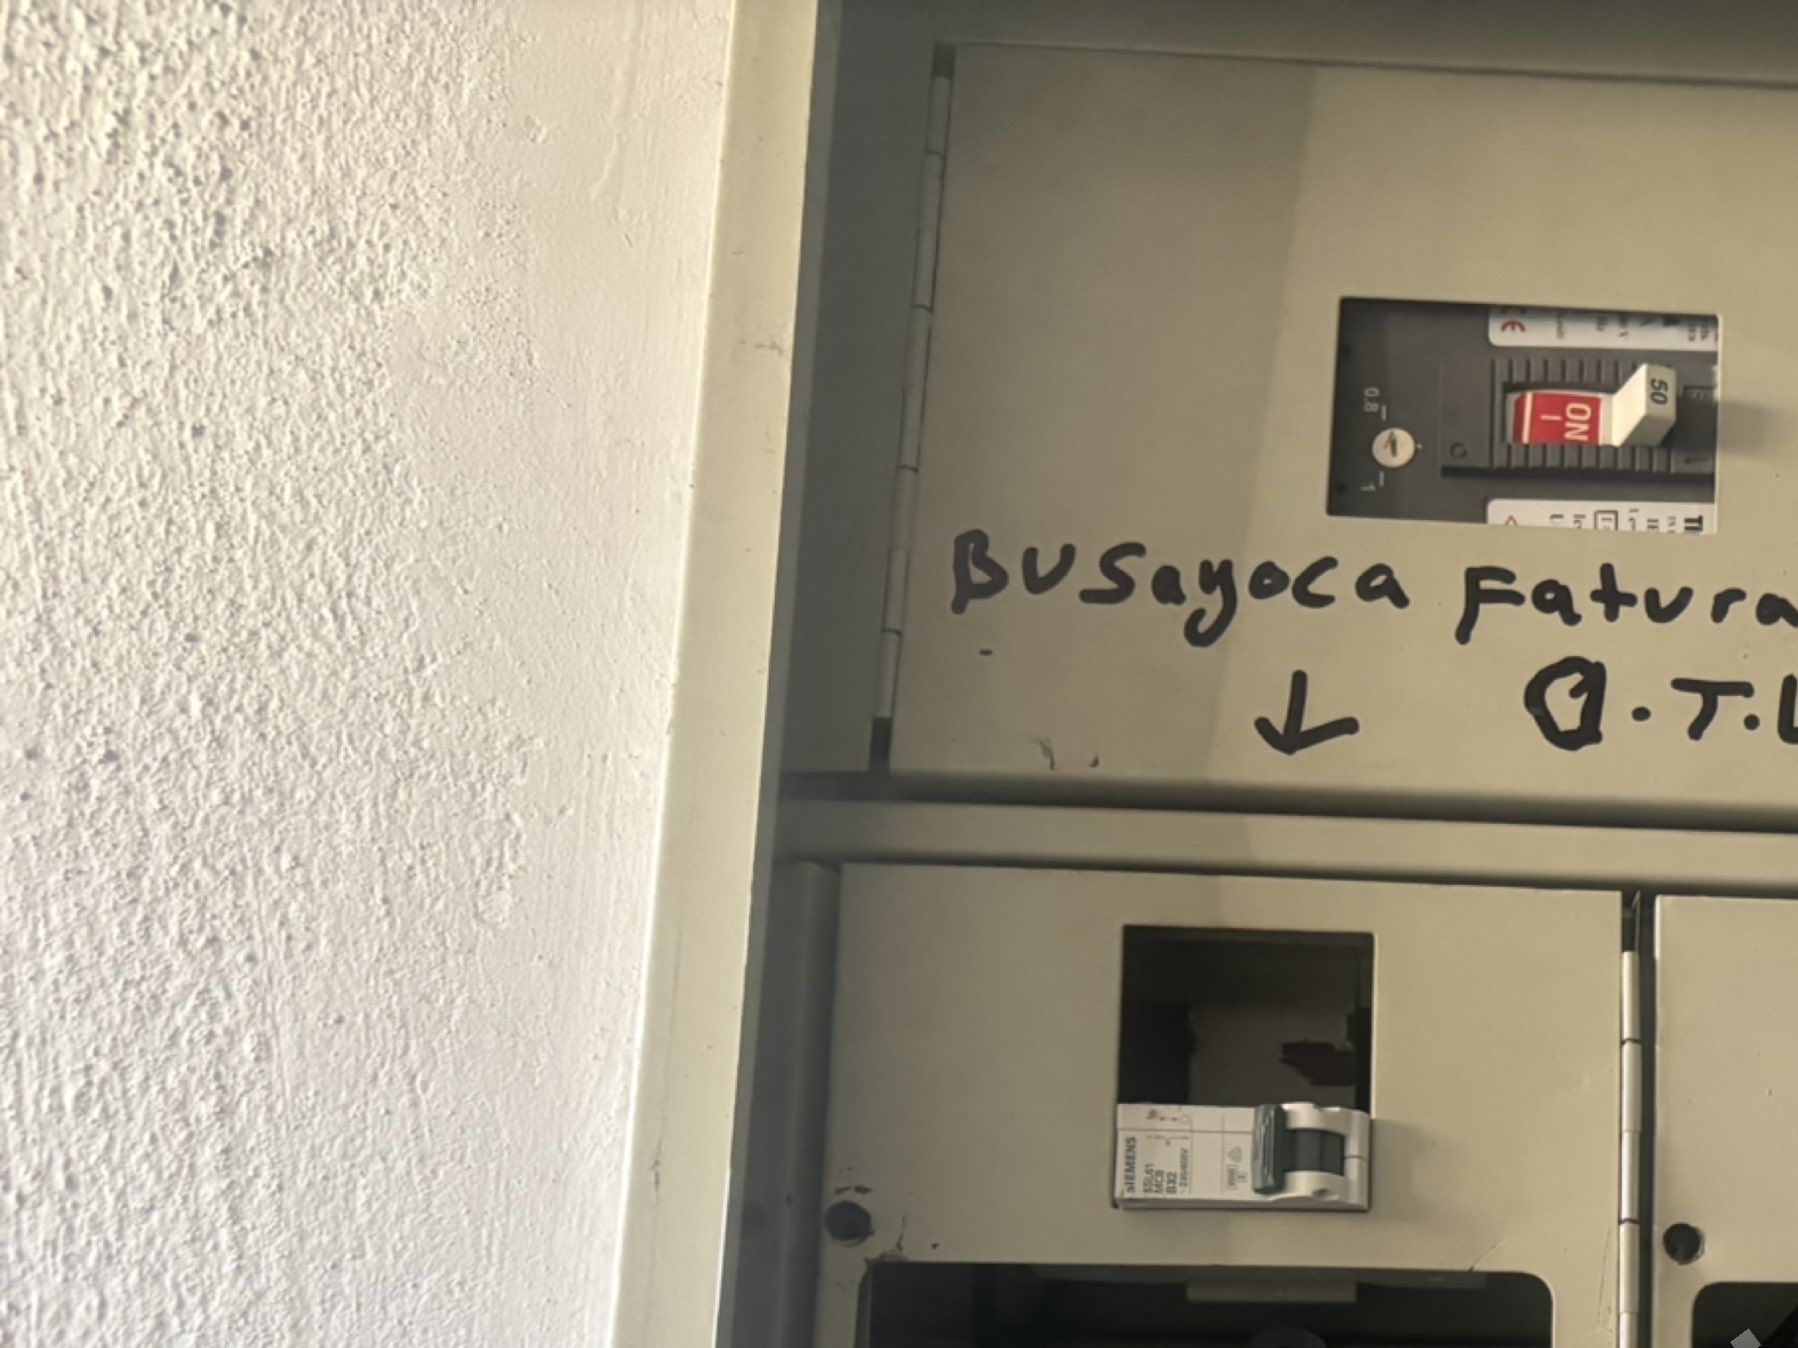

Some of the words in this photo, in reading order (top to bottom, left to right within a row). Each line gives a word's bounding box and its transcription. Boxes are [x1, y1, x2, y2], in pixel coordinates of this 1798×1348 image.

[1363, 386, 1381, 413] 0.8
[1648, 377, 1669, 406] 50
[1563, 402, 1593, 442] ON
